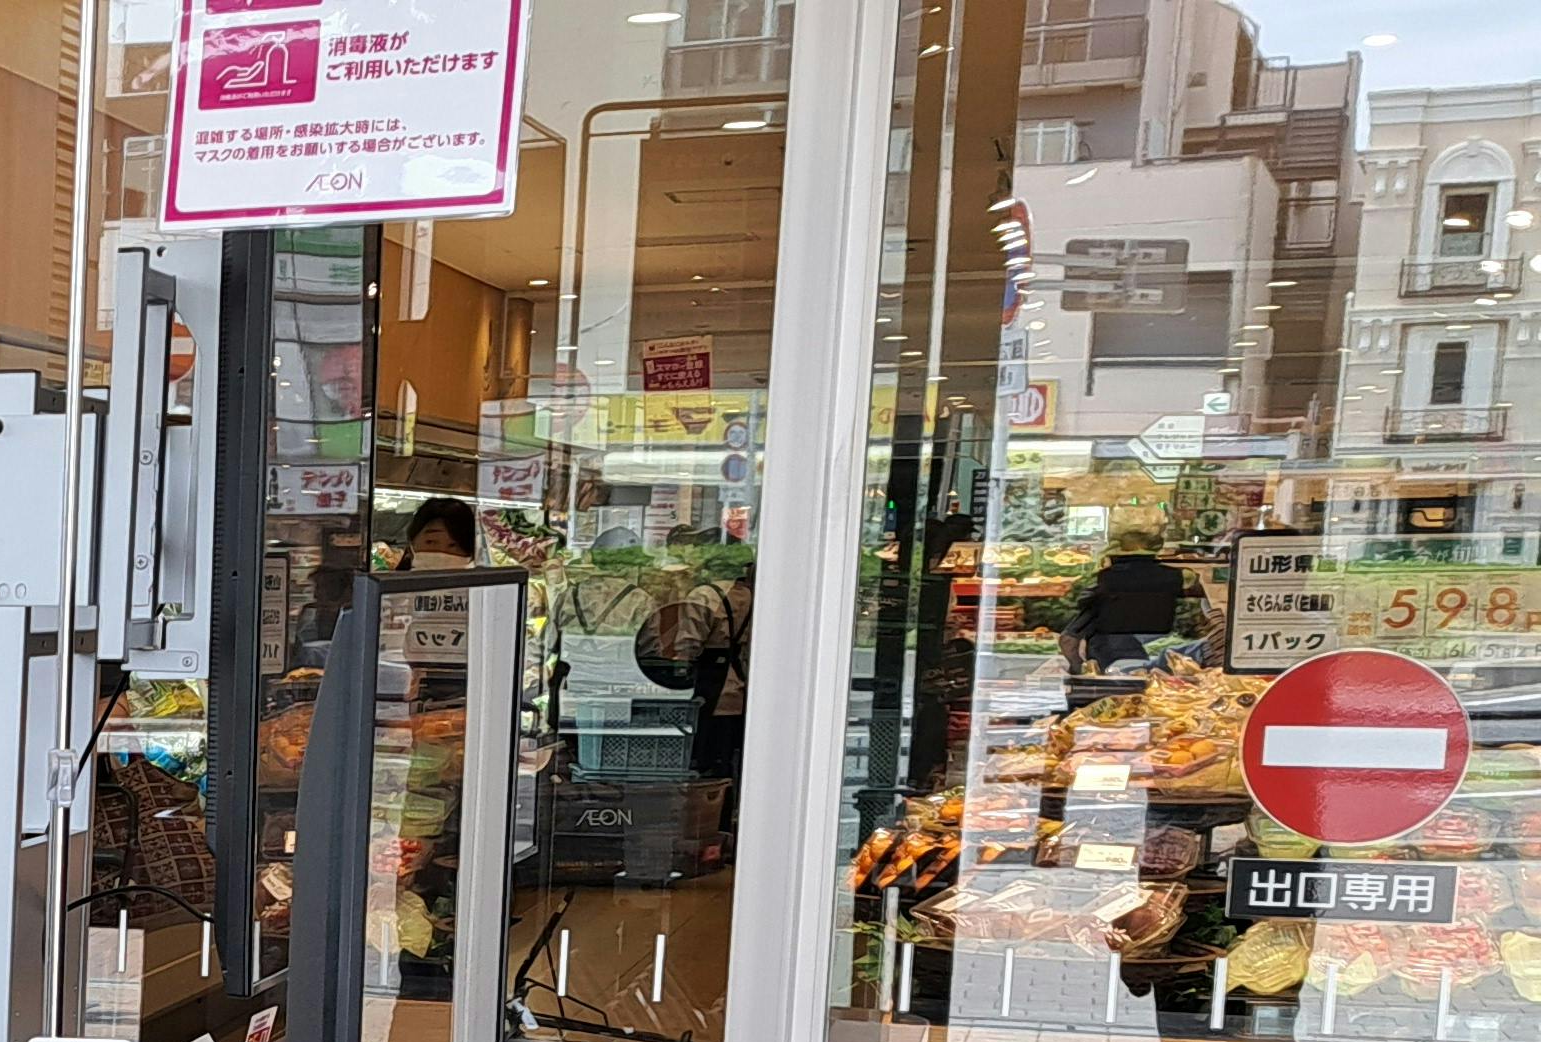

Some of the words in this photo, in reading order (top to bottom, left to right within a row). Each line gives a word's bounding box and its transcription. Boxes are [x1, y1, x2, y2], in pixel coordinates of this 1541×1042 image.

[327, 31, 410, 57] 消毒液が
[325, 51, 499, 81] ご利用いただけます
[194, 131, 487, 162] マスクの着用をお願いする場合がございます。
[195, 118, 408, 146] 混雑する場所・感染拡大時には、
[1243, 631, 1327, 652] 1パック
[1248, 870, 1436, 915] 出口専用
